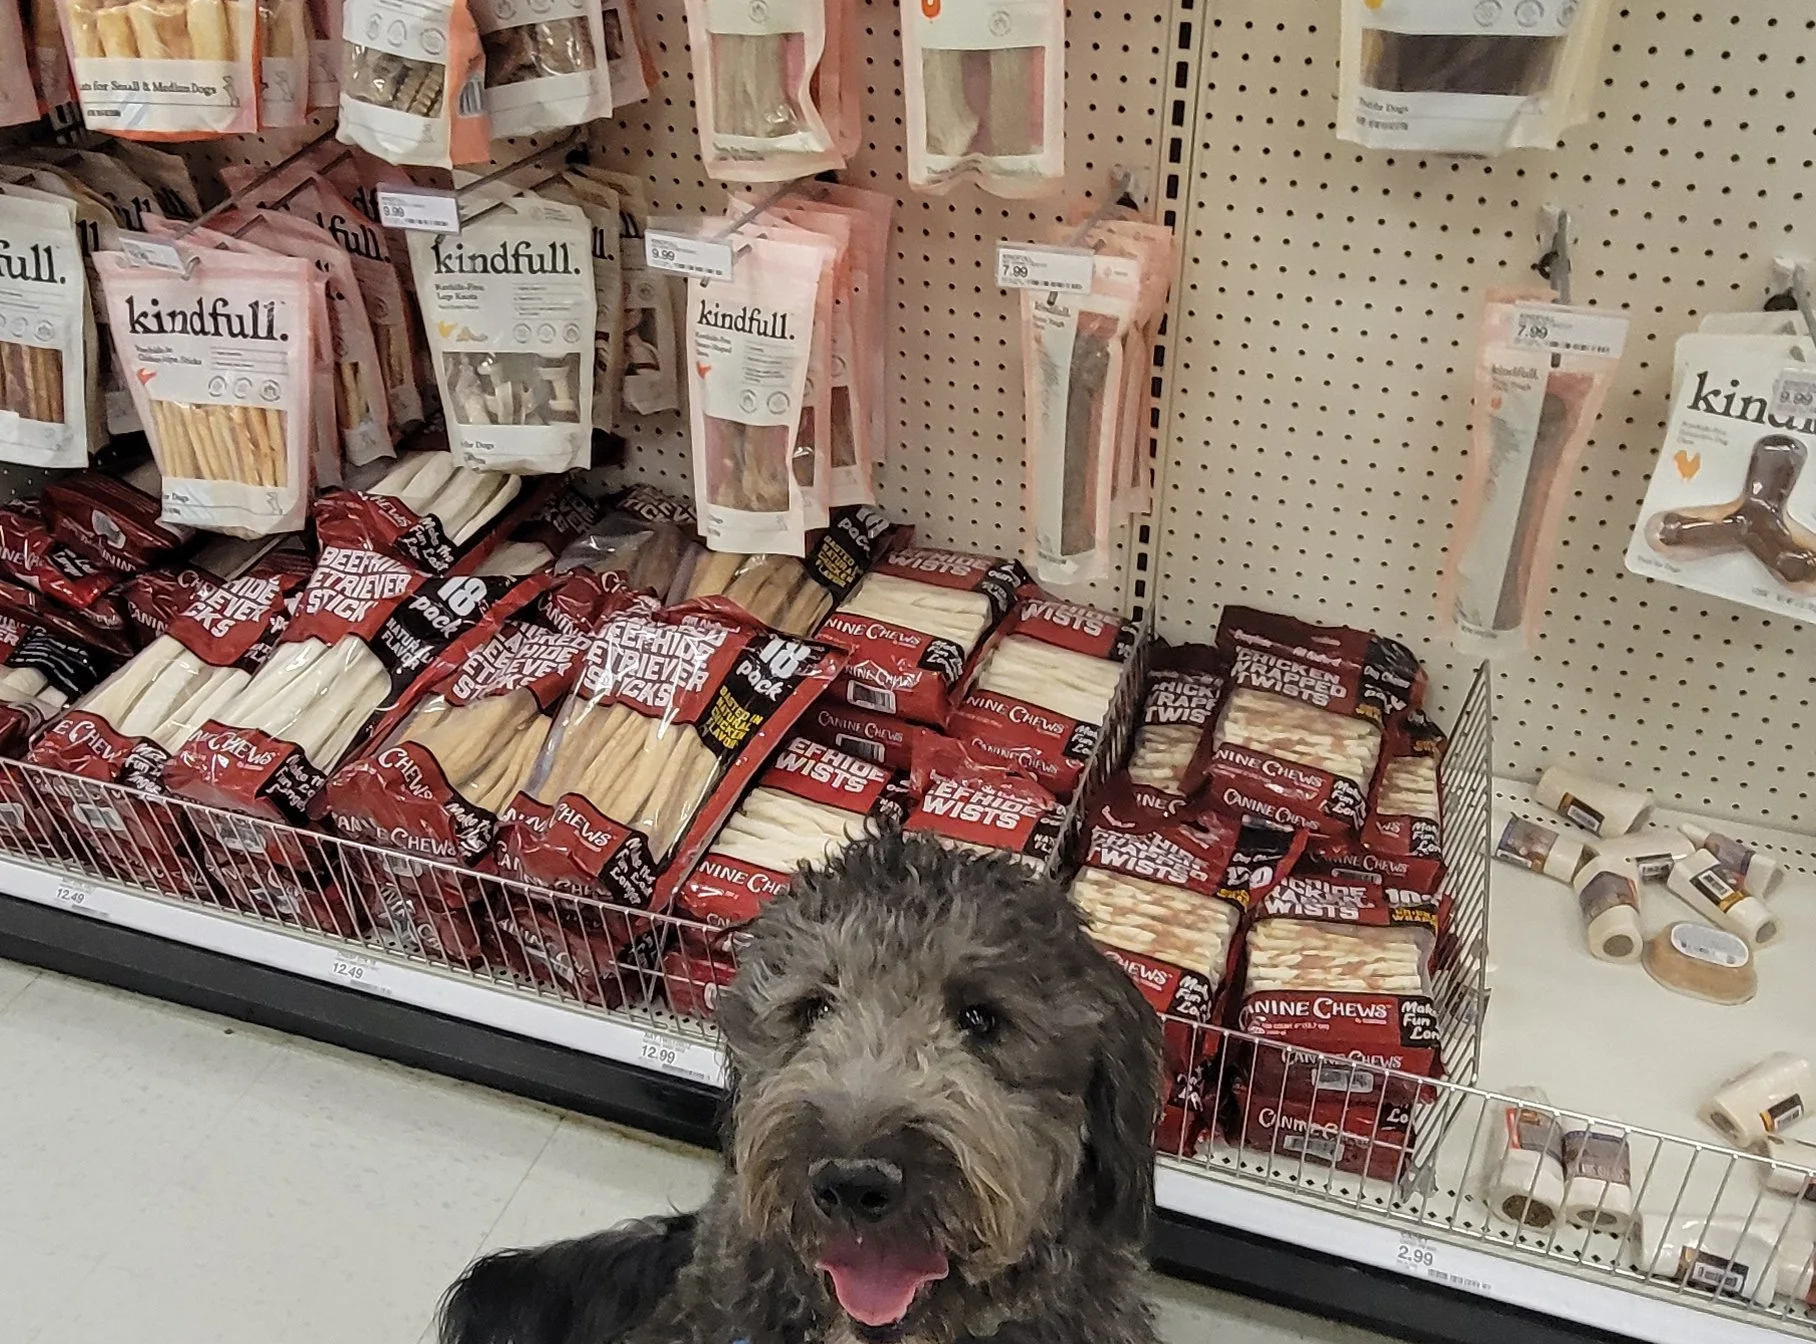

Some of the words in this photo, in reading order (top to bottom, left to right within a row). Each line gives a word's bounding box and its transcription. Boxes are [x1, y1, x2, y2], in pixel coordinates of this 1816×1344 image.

[94, 81, 108, 92] for
[111, 80, 139, 92] Small
[191, 84, 217, 96] Dogs
[383, 206, 405, 218] 9.99
[316, 212, 391, 263] full.
[652, 248, 675, 261] 9.99
[0, 239, 66, 285] full.
[430, 240, 581, 275] kindfull.
[1002, 265, 1028, 278] 7.99
[125, 294, 289, 342] kindfull.
[696, 299, 795, 340] kindfull.
[1517, 324, 1549, 340] 7.99
[888, 553, 972, 577] WISTS
[308, 570, 412, 600] ETRIEVER
[436, 576, 488, 616] 18
[181, 601, 237, 638] CKS
[306, 588, 378, 623] STICK
[408, 596, 464, 639] pack
[1020, 602, 1106, 638] WISTS
[824, 618, 867, 637] NINE
[865, 623, 922, 646] CHEWS
[586, 640, 710, 692] ETRIEVER
[735, 659, 785, 703] pack
[966, 695, 1007, 714] NINE
[1008, 706, 1066, 734] CHEWS
[1144, 707, 1213, 724] TWIS
[68, 720, 123, 763] CHEW
[774, 752, 869, 793] WISTS
[785, 737, 886, 783] EFHIDE
[1215, 749, 1261, 774] NINE
[1261, 760, 1324, 788] CHEWS
[922, 794, 1021, 830] WISTS
[929, 779, 1045, 818] EFHIDE
[1223, 787, 1275, 817] CANINE
[55, 887, 85, 905] 12.49
[699, 861, 748, 885] NINE
[746, 873, 791, 898] CHE
[1265, 900, 1360, 920] WISTS
[332, 962, 364, 980] 12.49
[1313, 997, 1388, 1019] CHEWS
[1402, 1014, 1431, 1027] Fun
[1409, 1026, 1441, 1040] Lon
[641, 1044, 676, 1065] 12.99
[1397, 1244, 1434, 1266] 2.99
